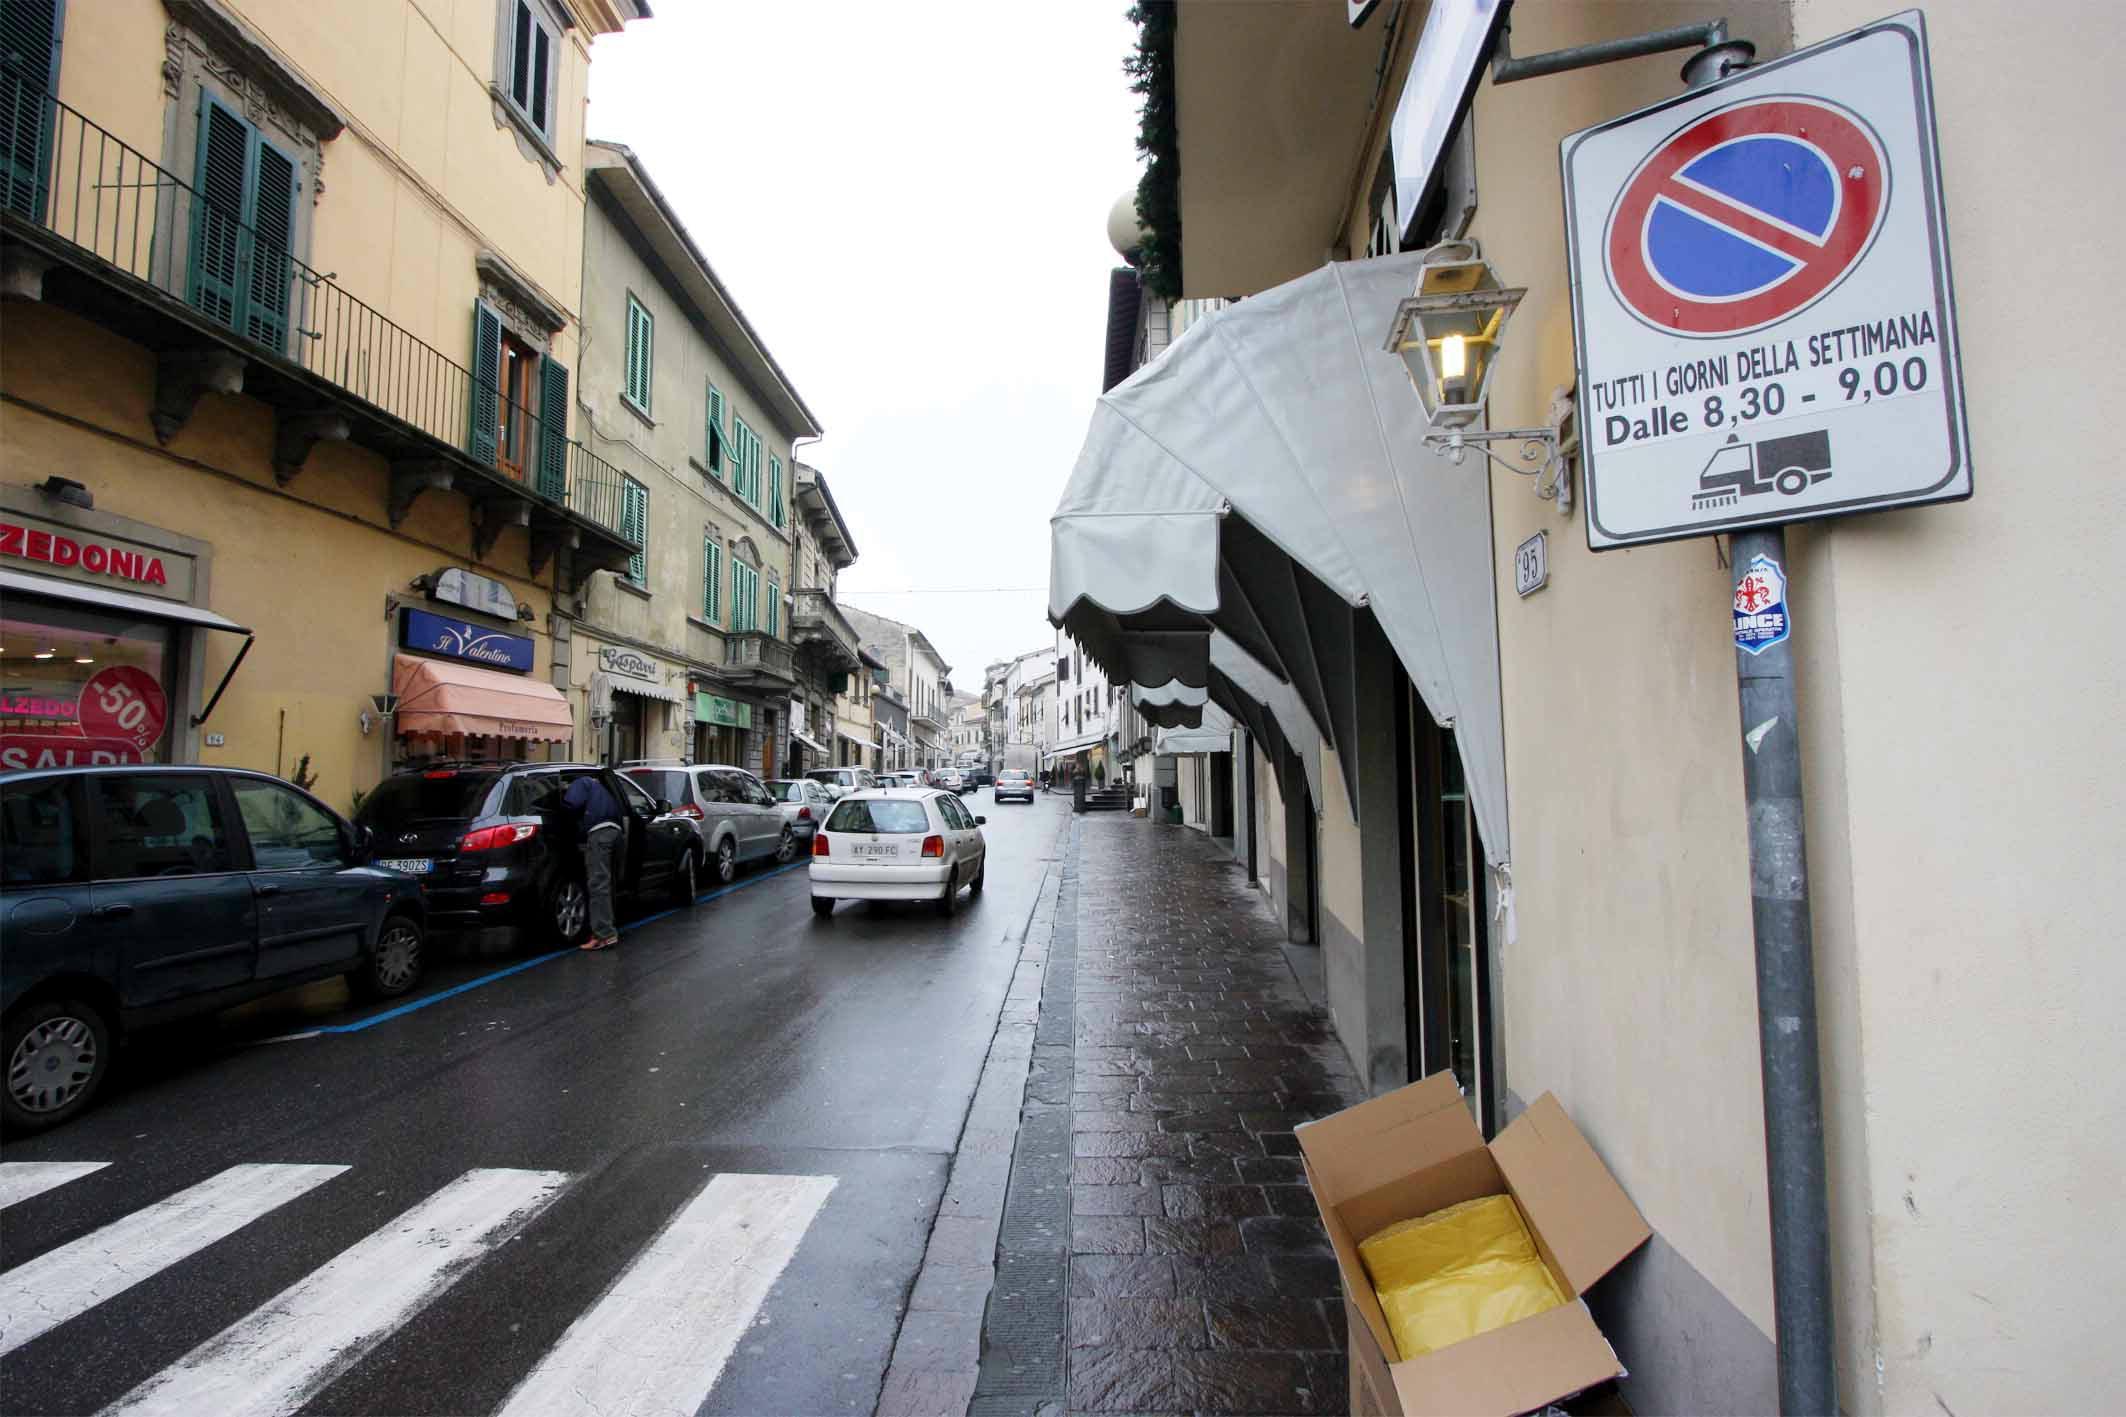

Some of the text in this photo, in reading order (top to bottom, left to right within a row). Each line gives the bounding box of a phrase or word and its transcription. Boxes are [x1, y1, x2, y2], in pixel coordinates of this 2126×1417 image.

[1592, 311, 1935, 413] TUTTI I GIORNI DELLA SETTIMANA
[1605, 406, 1689, 445] Dalle
[1703, 383, 1785, 428] 8,30
[1838, 356, 1927, 404] 9,00
[0, 523, 167, 585] ZEDONIA
[1523, 549, 1538, 582] 95
[444, 626, 513, 664] Valentino
